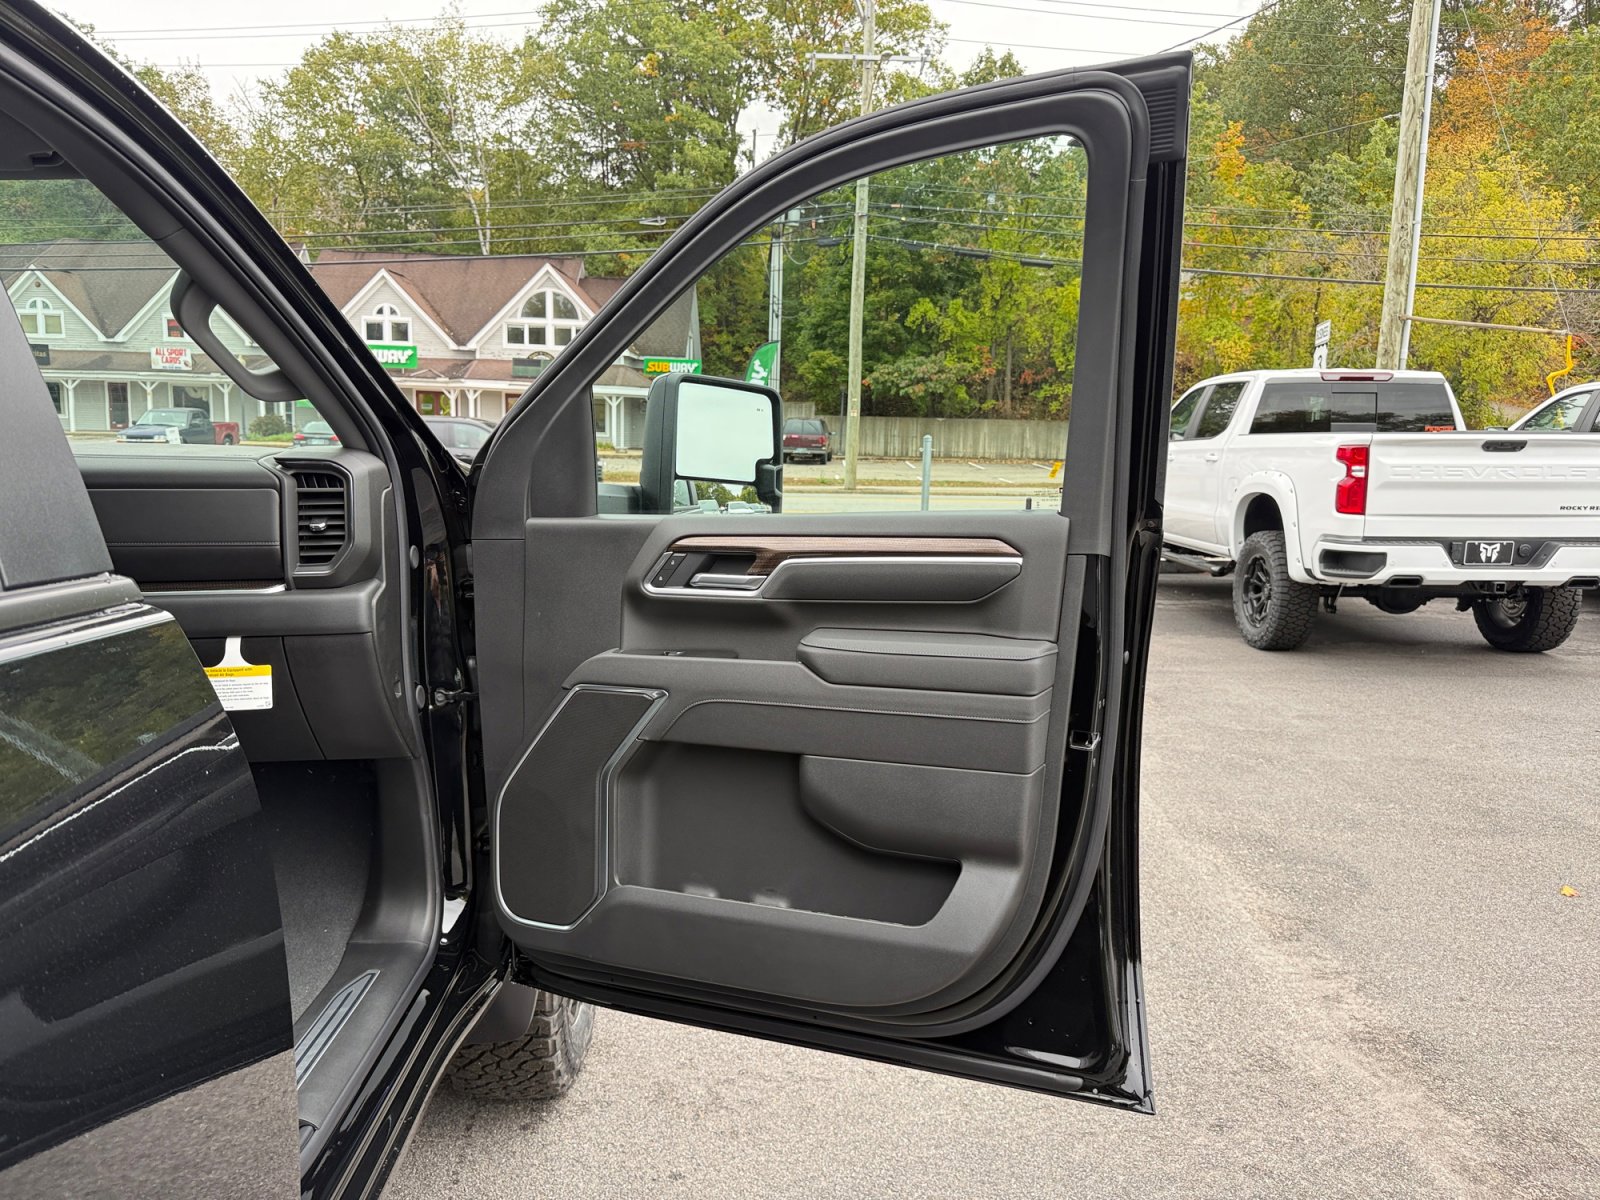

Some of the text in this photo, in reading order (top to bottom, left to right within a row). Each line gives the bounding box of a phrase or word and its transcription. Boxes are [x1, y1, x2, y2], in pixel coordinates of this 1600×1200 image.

[155, 347, 187, 357] ALL SPORT
[646, 361, 699, 374] SUBWAY
